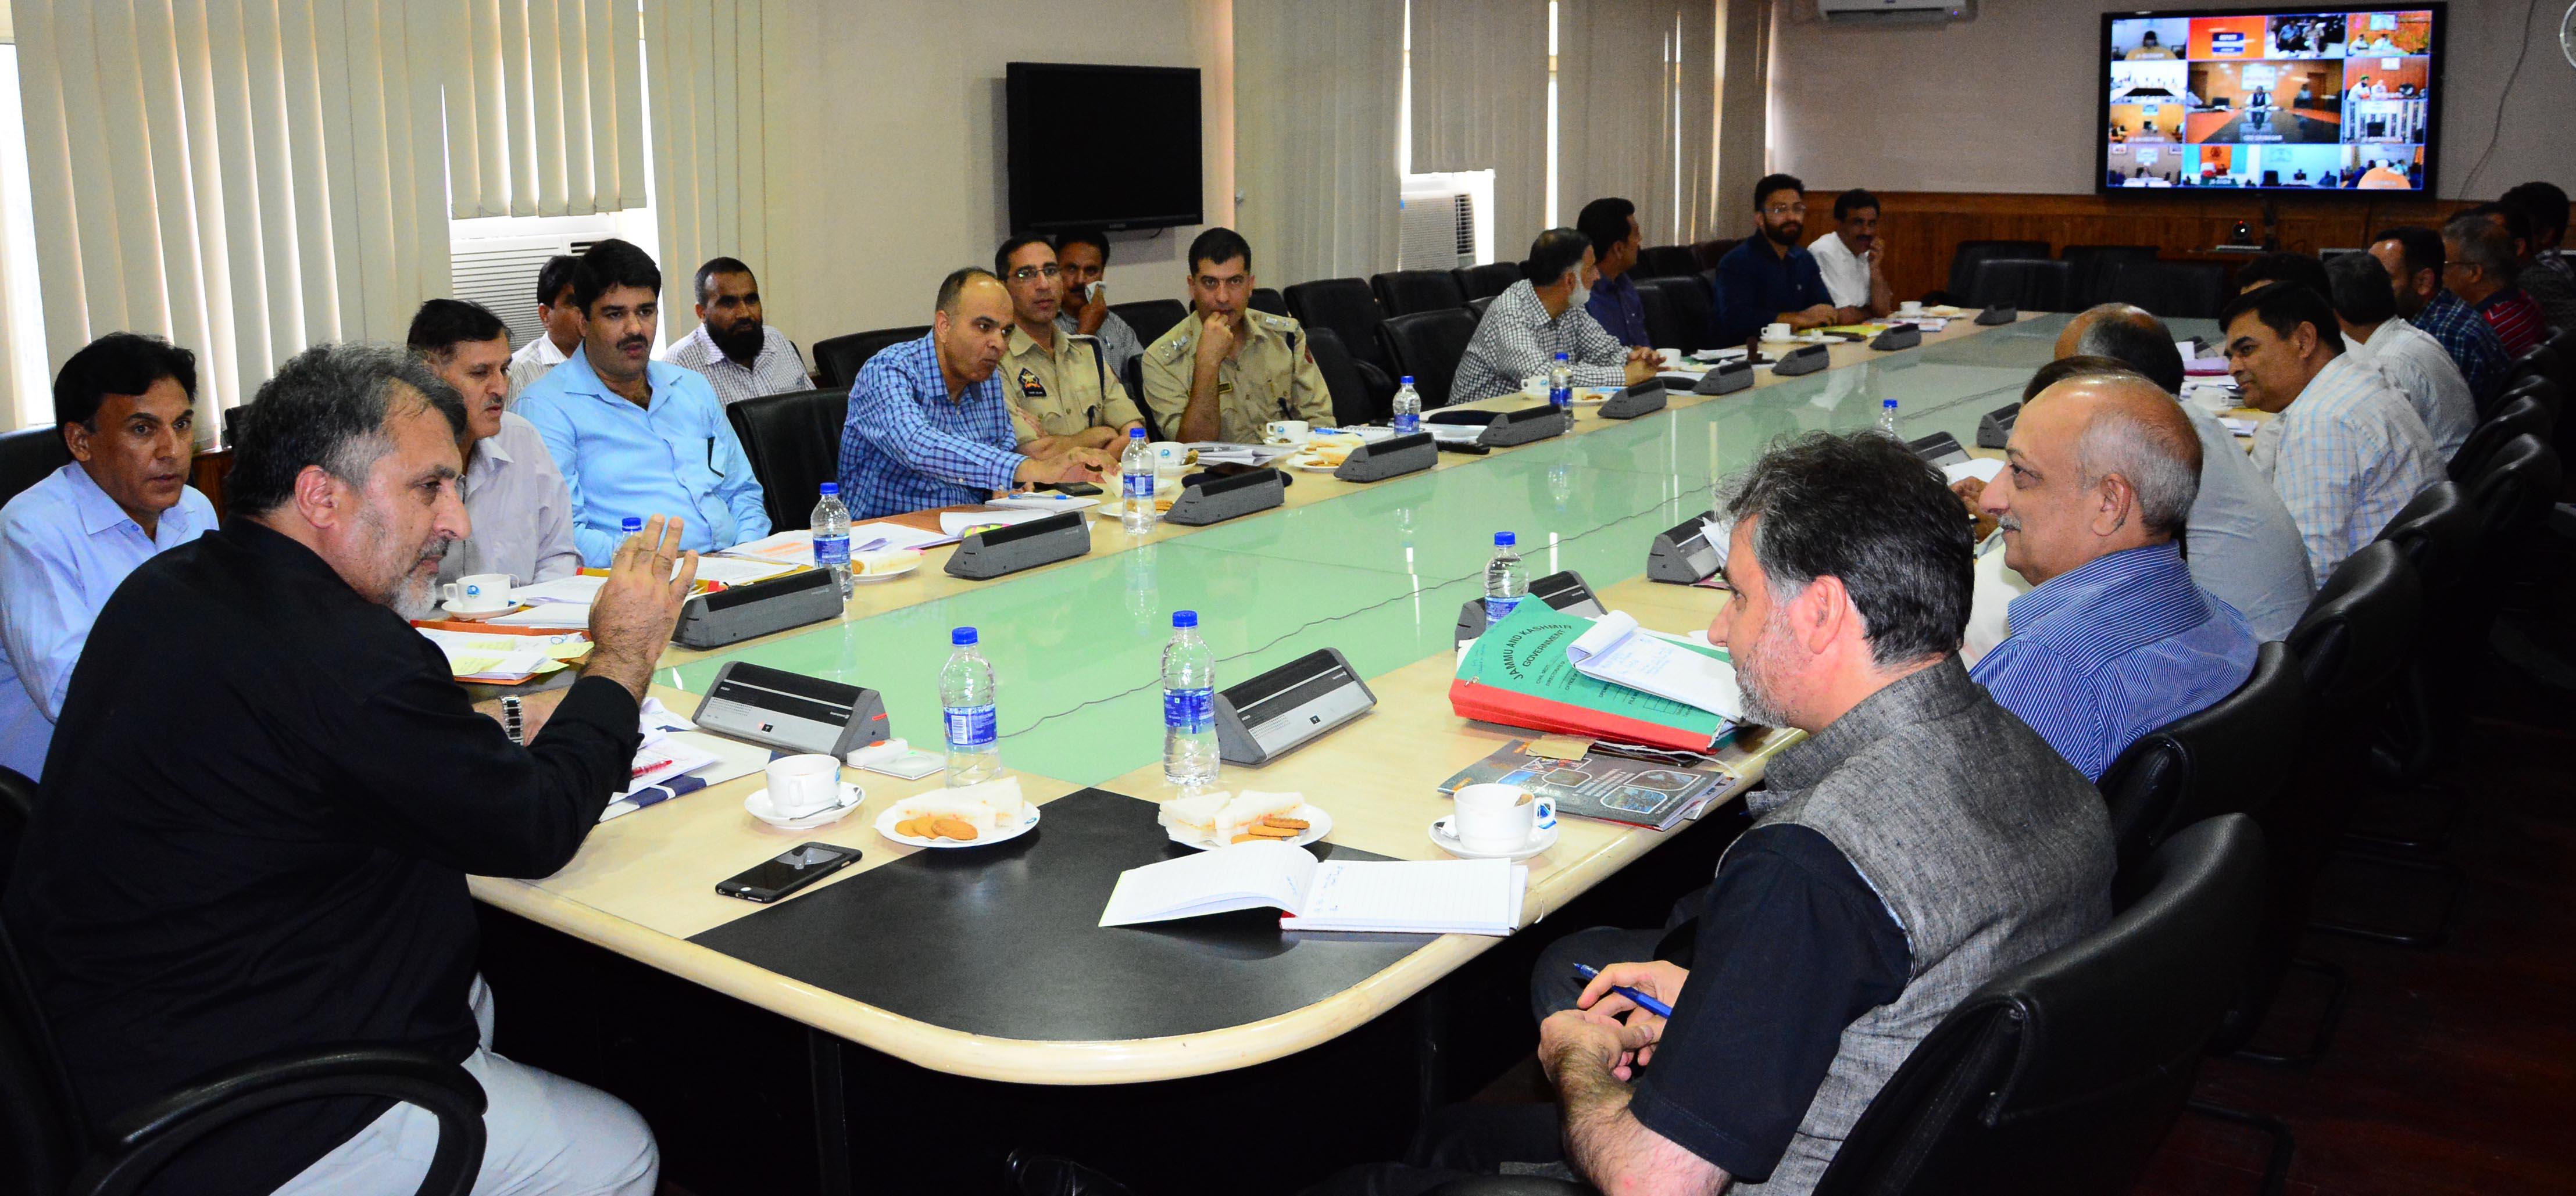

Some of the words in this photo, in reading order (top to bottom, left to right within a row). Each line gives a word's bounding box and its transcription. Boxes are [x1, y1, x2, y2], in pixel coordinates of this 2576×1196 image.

[1506, 635, 1522, 647] AND
[1520, 625, 1571, 636] KASHMIR
[1523, 629, 1565, 667] GOVERNMENT
[1503, 649, 1523, 680] JAMMU
